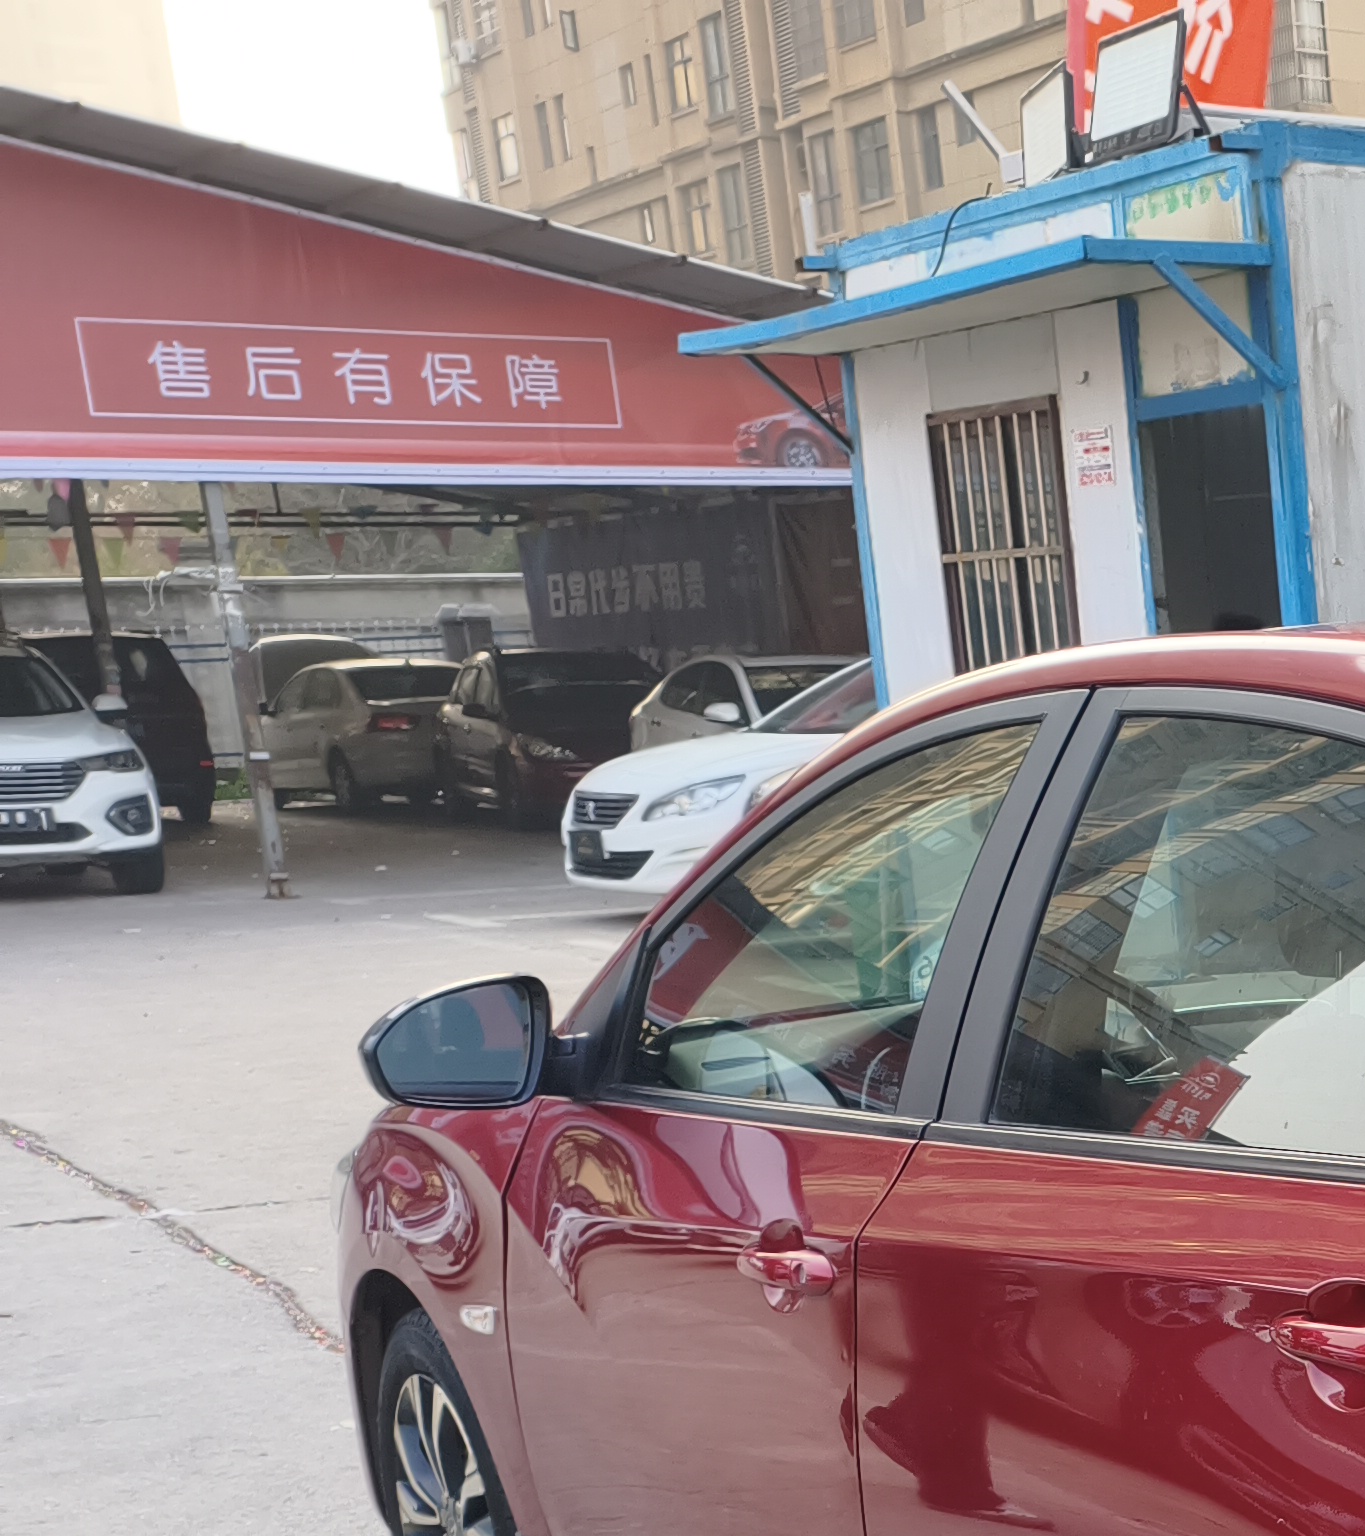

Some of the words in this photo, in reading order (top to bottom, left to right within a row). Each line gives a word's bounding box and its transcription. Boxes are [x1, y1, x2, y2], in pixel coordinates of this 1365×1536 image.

[147, 340, 562, 409] 售后有保障
